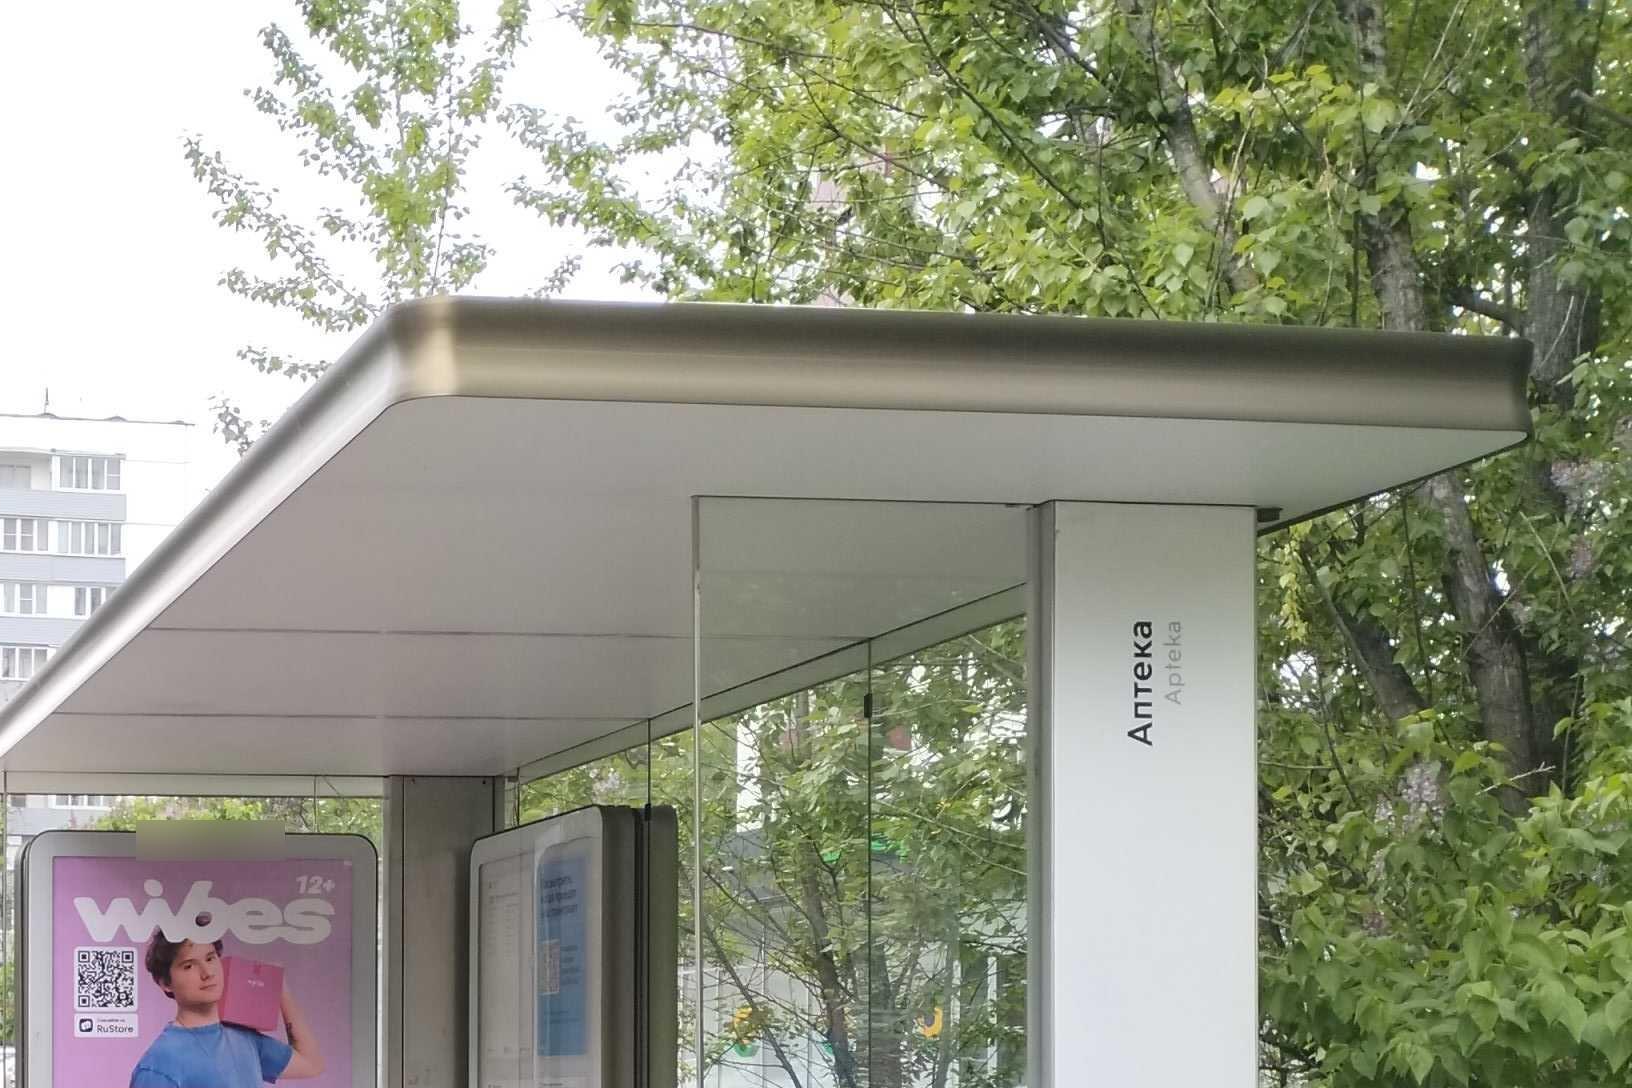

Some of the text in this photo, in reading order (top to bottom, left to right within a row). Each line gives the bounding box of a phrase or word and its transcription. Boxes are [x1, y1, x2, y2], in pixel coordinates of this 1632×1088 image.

[1127, 620, 1153, 746] Аптека
[1163, 620, 1186, 706] Apteka
[73, 879, 336, 945] wibes
[296, 875, 336, 894] 12+
[96, 1024, 134, 1033] RuStore
